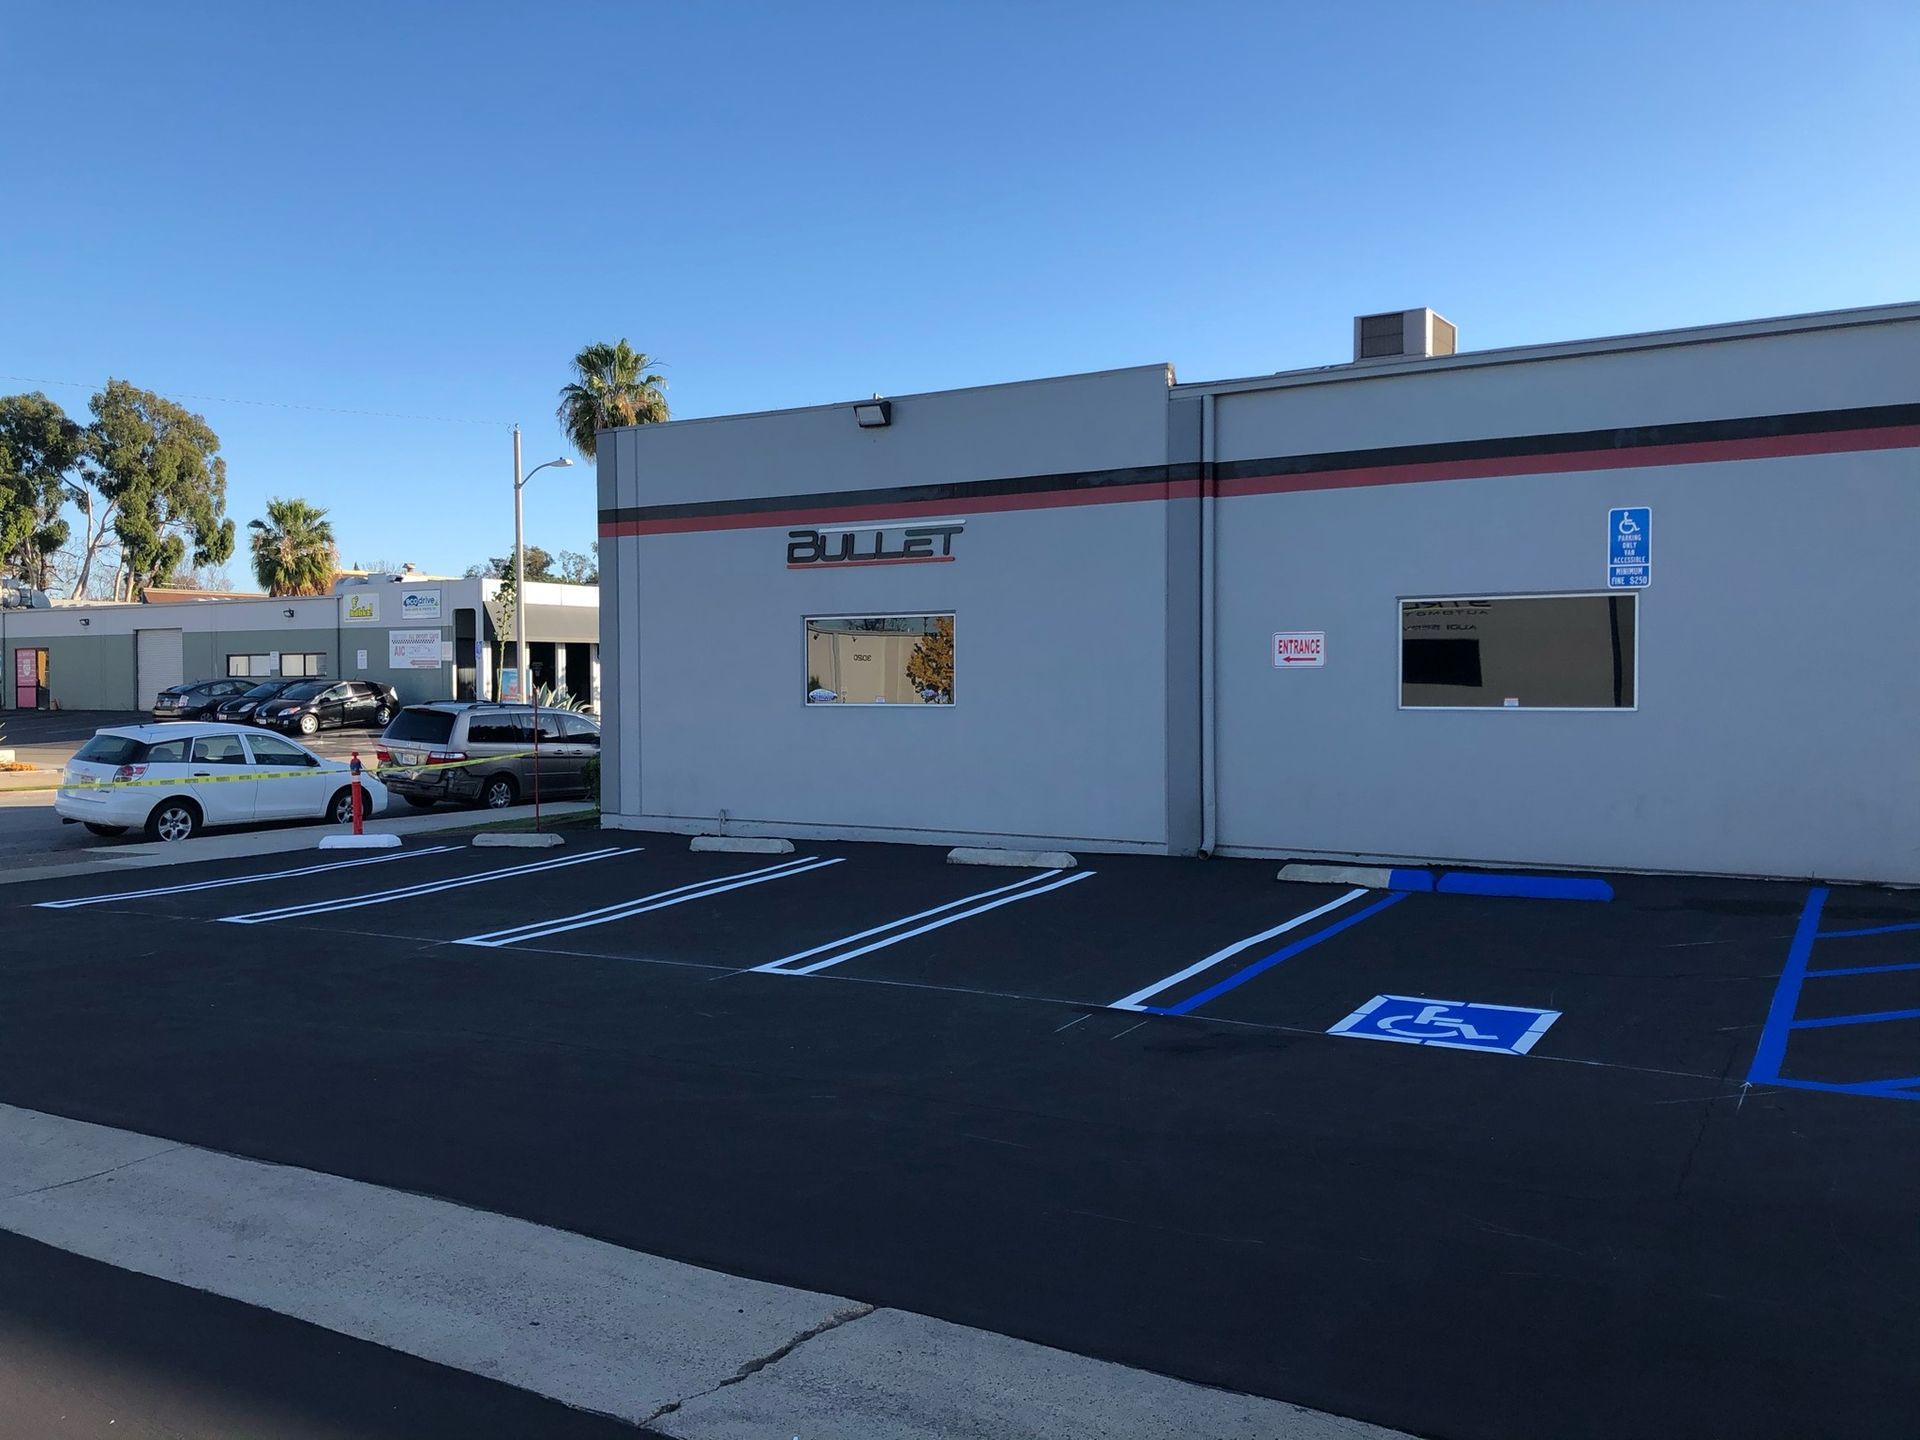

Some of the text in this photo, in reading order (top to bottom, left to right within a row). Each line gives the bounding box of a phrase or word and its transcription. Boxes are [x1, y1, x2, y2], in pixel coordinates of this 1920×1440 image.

[1617, 534, 1642, 542] PARKING
[787, 526, 964, 563] BULLET
[1613, 556, 1646, 564] ACCESSIBLE
[1616, 567, 1643, 576] MINIMUM
[1611, 577, 1625, 585] FINE
[1278, 639, 1320, 654] ENTRANCE
